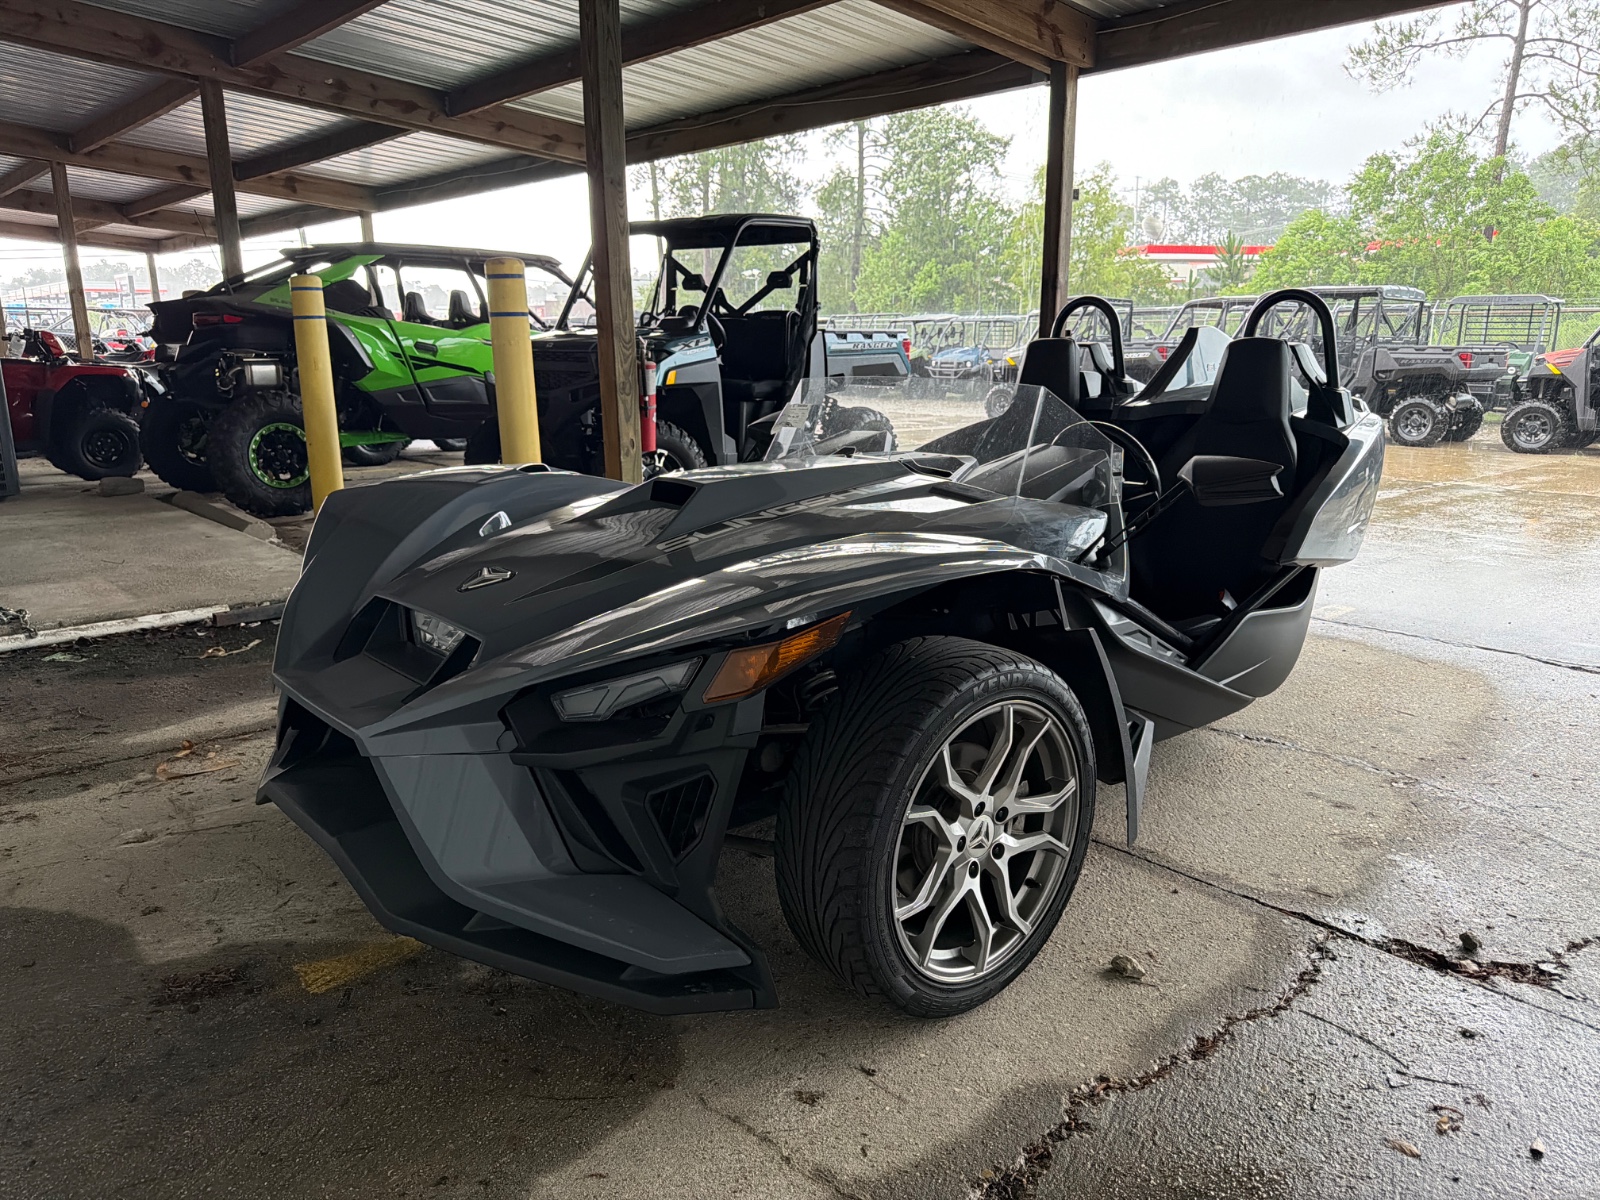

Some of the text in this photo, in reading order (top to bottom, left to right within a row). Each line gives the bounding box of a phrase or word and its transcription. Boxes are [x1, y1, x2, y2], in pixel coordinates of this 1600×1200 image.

[678, 337, 710, 351] XP
[852, 341, 894, 350] RANGER
[973, 672, 1034, 702] KENDA
